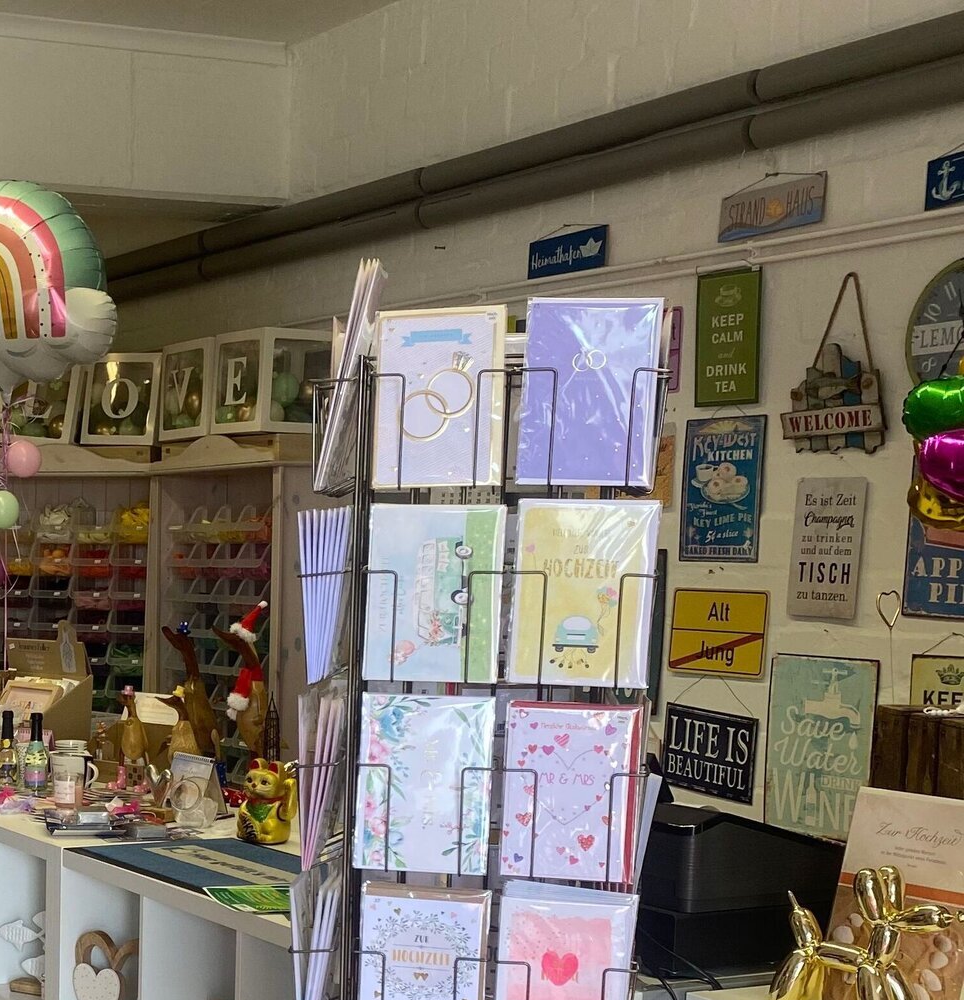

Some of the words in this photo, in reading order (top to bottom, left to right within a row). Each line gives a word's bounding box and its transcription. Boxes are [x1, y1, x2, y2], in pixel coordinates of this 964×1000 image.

[728, 197, 766, 227] STRAND
[786, 186, 814, 217] HAUS
[531, 244, 582, 270] Heimathafen
[711, 313, 744, 328] KEEP
[711, 330, 744, 344] CALM
[706, 363, 747, 377] DRINK
[715, 381, 737, 392] TEA
[788, 409, 873, 433] WELCOME
[707, 449, 753, 462] KITCHEN
[805, 494, 817, 506] Es
[820, 494, 833, 506] ist
[835, 495, 856, 506] Zeit
[693, 516, 711, 528] KEY
[714, 514, 735, 526] LIME
[738, 512, 753, 524] PIE
[804, 511, 854, 530] Champagner
[816, 535, 852, 543] trinken
[801, 545, 816, 555] und
[819, 546, 833, 556] auf
[834, 547, 852, 556] dem
[543, 558, 620, 579] HOCHZEIT
[799, 562, 851, 584] TISCH
[797, 591, 808, 600] zu
[811, 590, 848, 602] tanzen.
[928, 583, 964, 605] PI
[707, 602, 730, 622] Alt
[697, 640, 735, 666] Jung
[781, 705, 847, 741] Save
[669, 715, 721, 759] LIFE
[724, 726, 750, 765] IS
[774, 736, 862, 776] Water
[539, 773, 555, 785] MR
[559, 773, 569, 785] &
[667, 752, 746, 791] BEAUTIFUL
[876, 822, 900, 838] Zur
[904, 826, 964, 849] Hochzeit
[392, 949, 450, 966] HOCHZEIT
